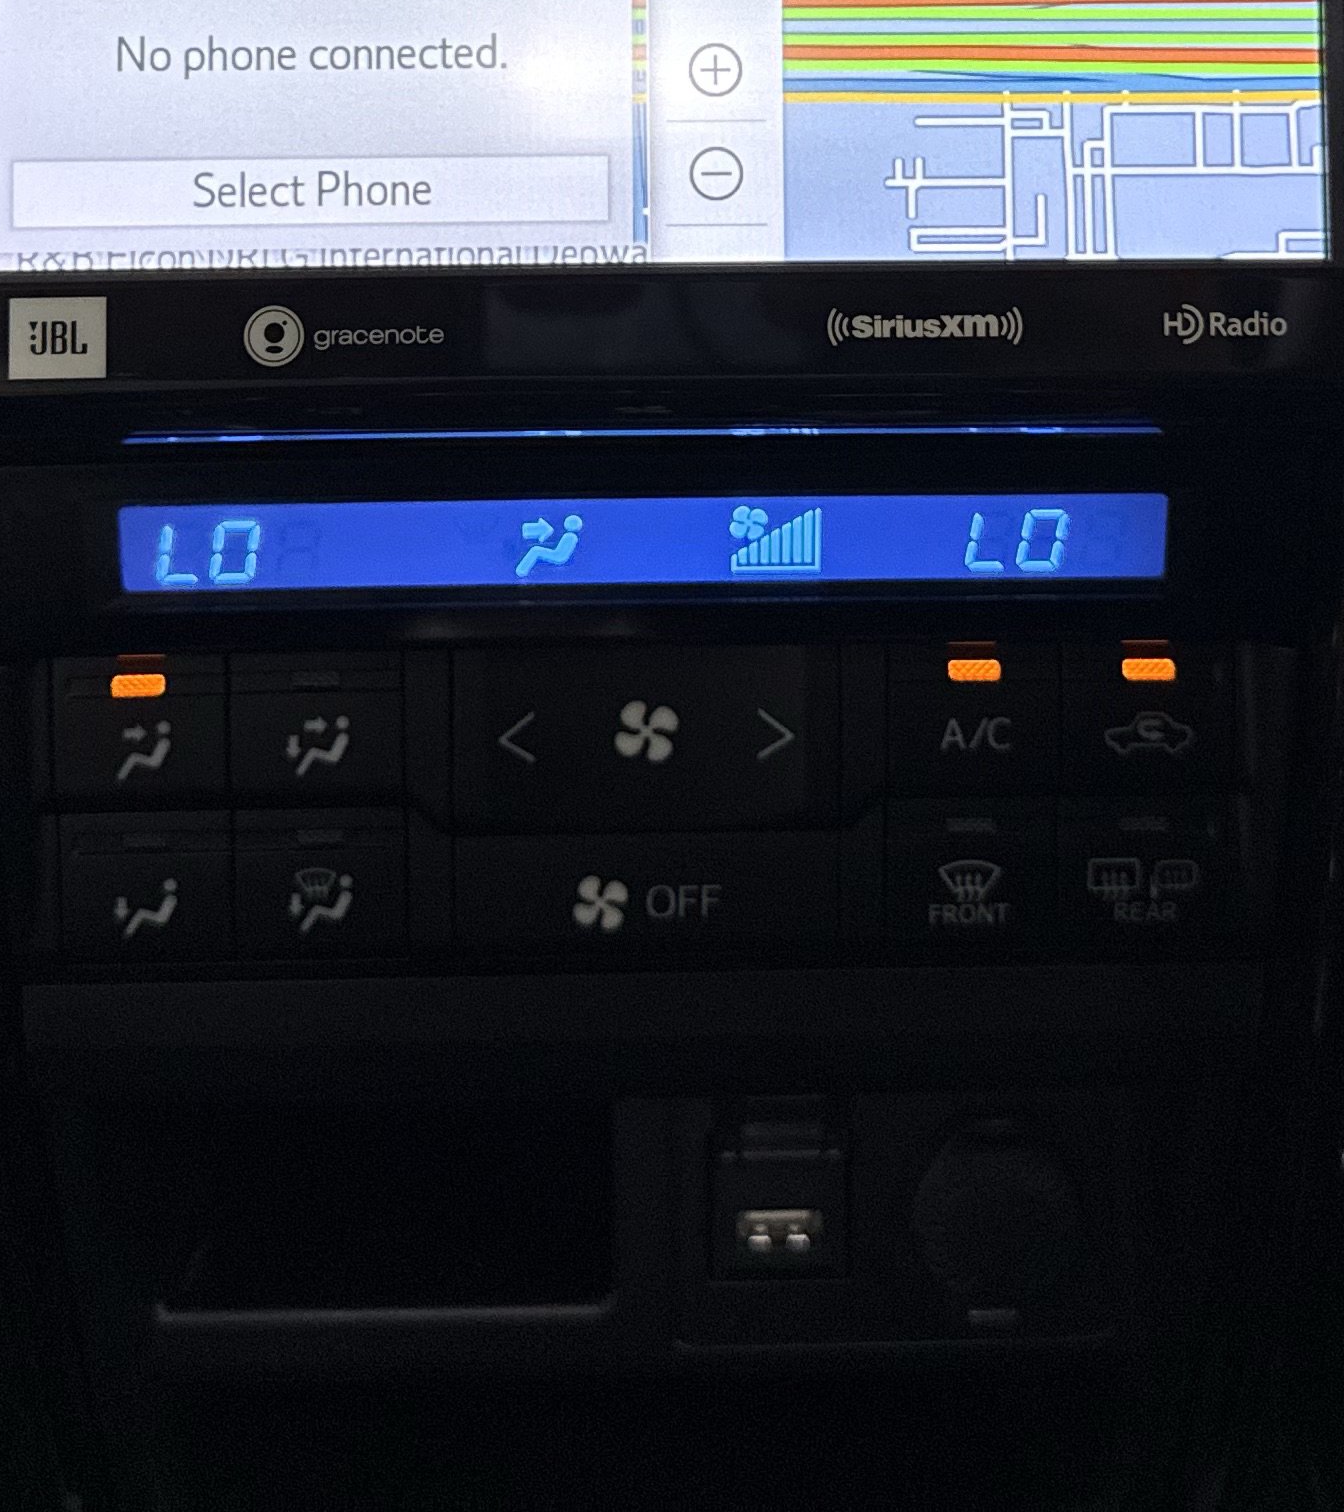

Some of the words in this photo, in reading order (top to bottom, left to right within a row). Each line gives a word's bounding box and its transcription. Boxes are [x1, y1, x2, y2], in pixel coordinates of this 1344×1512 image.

[116, 36, 175, 74] No
[184, 35, 296, 80] phone
[309, 33, 509, 71] connected.
[193, 172, 305, 209] Select
[317, 170, 432, 207] Phone
[29, 320, 88, 355] JBL
[313, 325, 445, 351] gracenote
[1209, 310, 1288, 337] Radio
[940, 716, 1012, 751] A/C
[646, 884, 722, 918] OFF
[928, 903, 1012, 925] FRONT
[1114, 900, 1178, 922] REAR
